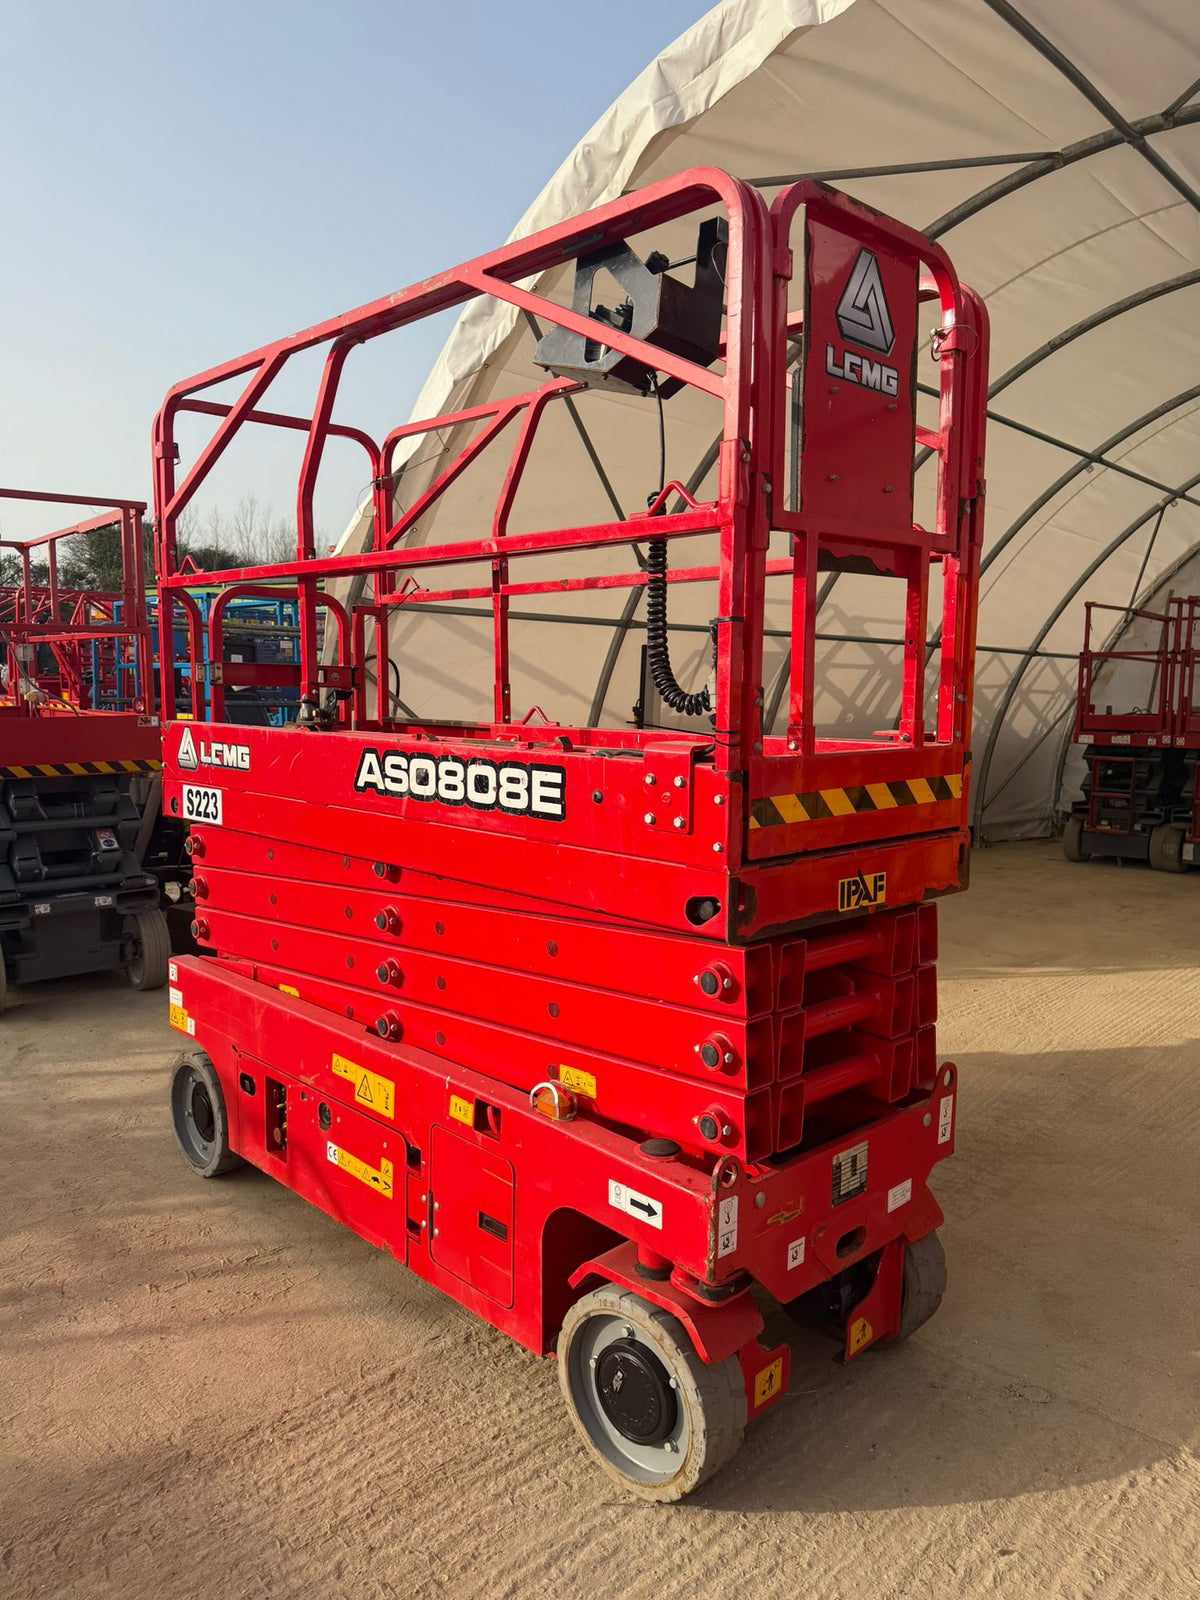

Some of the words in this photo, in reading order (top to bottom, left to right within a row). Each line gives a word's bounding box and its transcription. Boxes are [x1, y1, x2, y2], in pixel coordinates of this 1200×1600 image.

[186, 788, 219, 821] S223
[356, 752, 563, 816] AS0808E
[840, 868, 885, 910] IPAF
